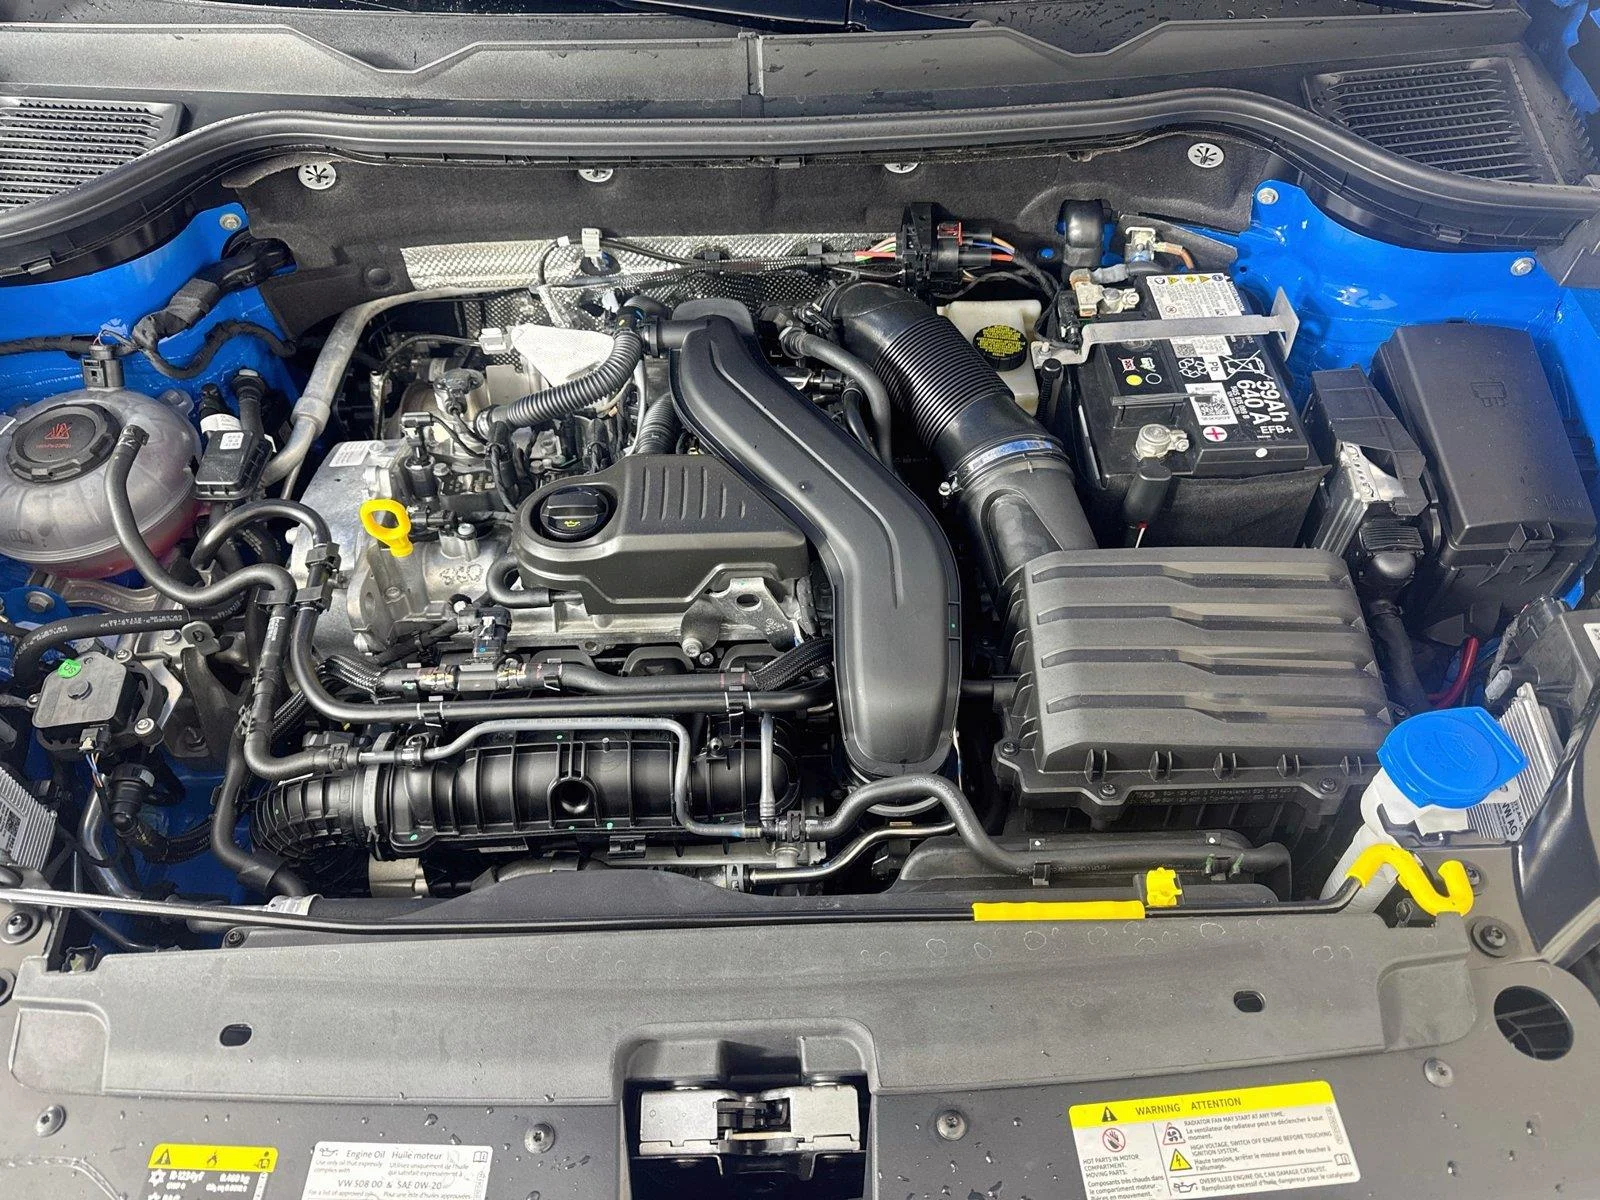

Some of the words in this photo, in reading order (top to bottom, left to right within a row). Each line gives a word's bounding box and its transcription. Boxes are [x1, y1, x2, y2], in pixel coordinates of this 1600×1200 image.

[1209, 361, 1219, 372] Pb
[1237, 380, 1264, 408] 640
[1257, 381, 1289, 422] 59Ah
[1249, 412, 1271, 425] A
[1260, 425, 1293, 434] EFB+
[1507, 819, 1518, 836] AG
[1136, 1104, 1180, 1116] WARNING
[1191, 1097, 1241, 1110] ATTENTION
[1235, 1114, 1250, 1122] START
[346, 1150, 372, 1159] Engine
[1084, 1163, 1127, 1172] COMPARTMENT.
[1088, 1179, 1120, 1187] Composants
